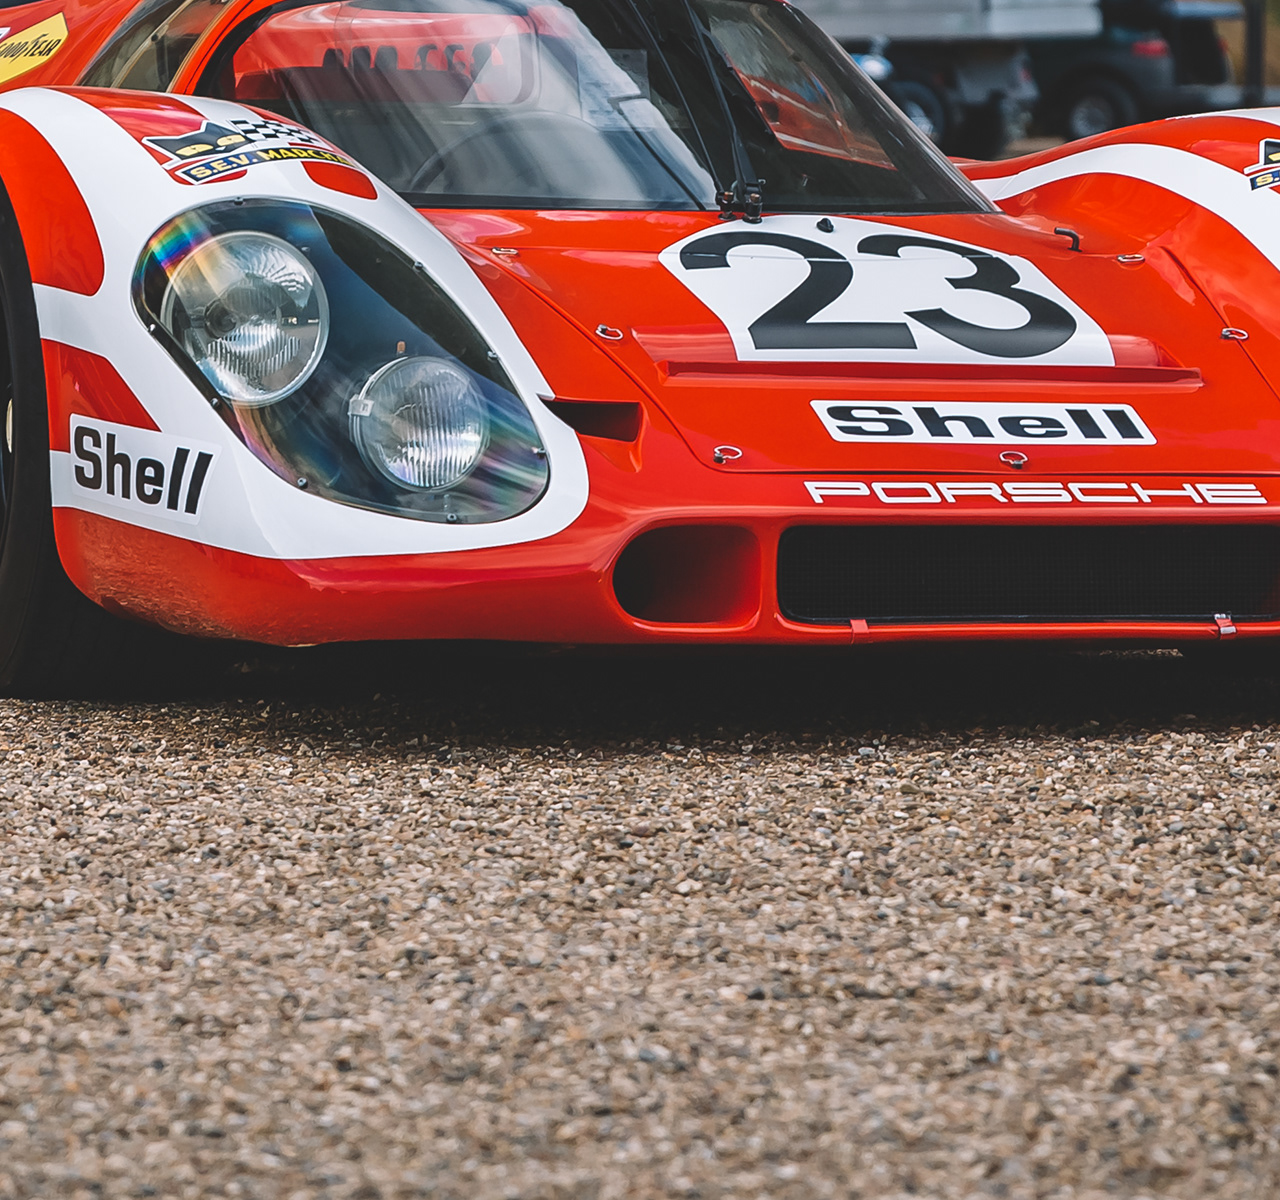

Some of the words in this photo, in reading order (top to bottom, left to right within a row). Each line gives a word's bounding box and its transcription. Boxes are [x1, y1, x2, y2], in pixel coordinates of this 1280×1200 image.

[190, 154, 257, 179] S.E.V.
[680, 231, 1077, 358] 23
[826, 405, 1144, 439] Shell
[74, 426, 214, 515] Shell
[803, 481, 1267, 504] PORSCHE
